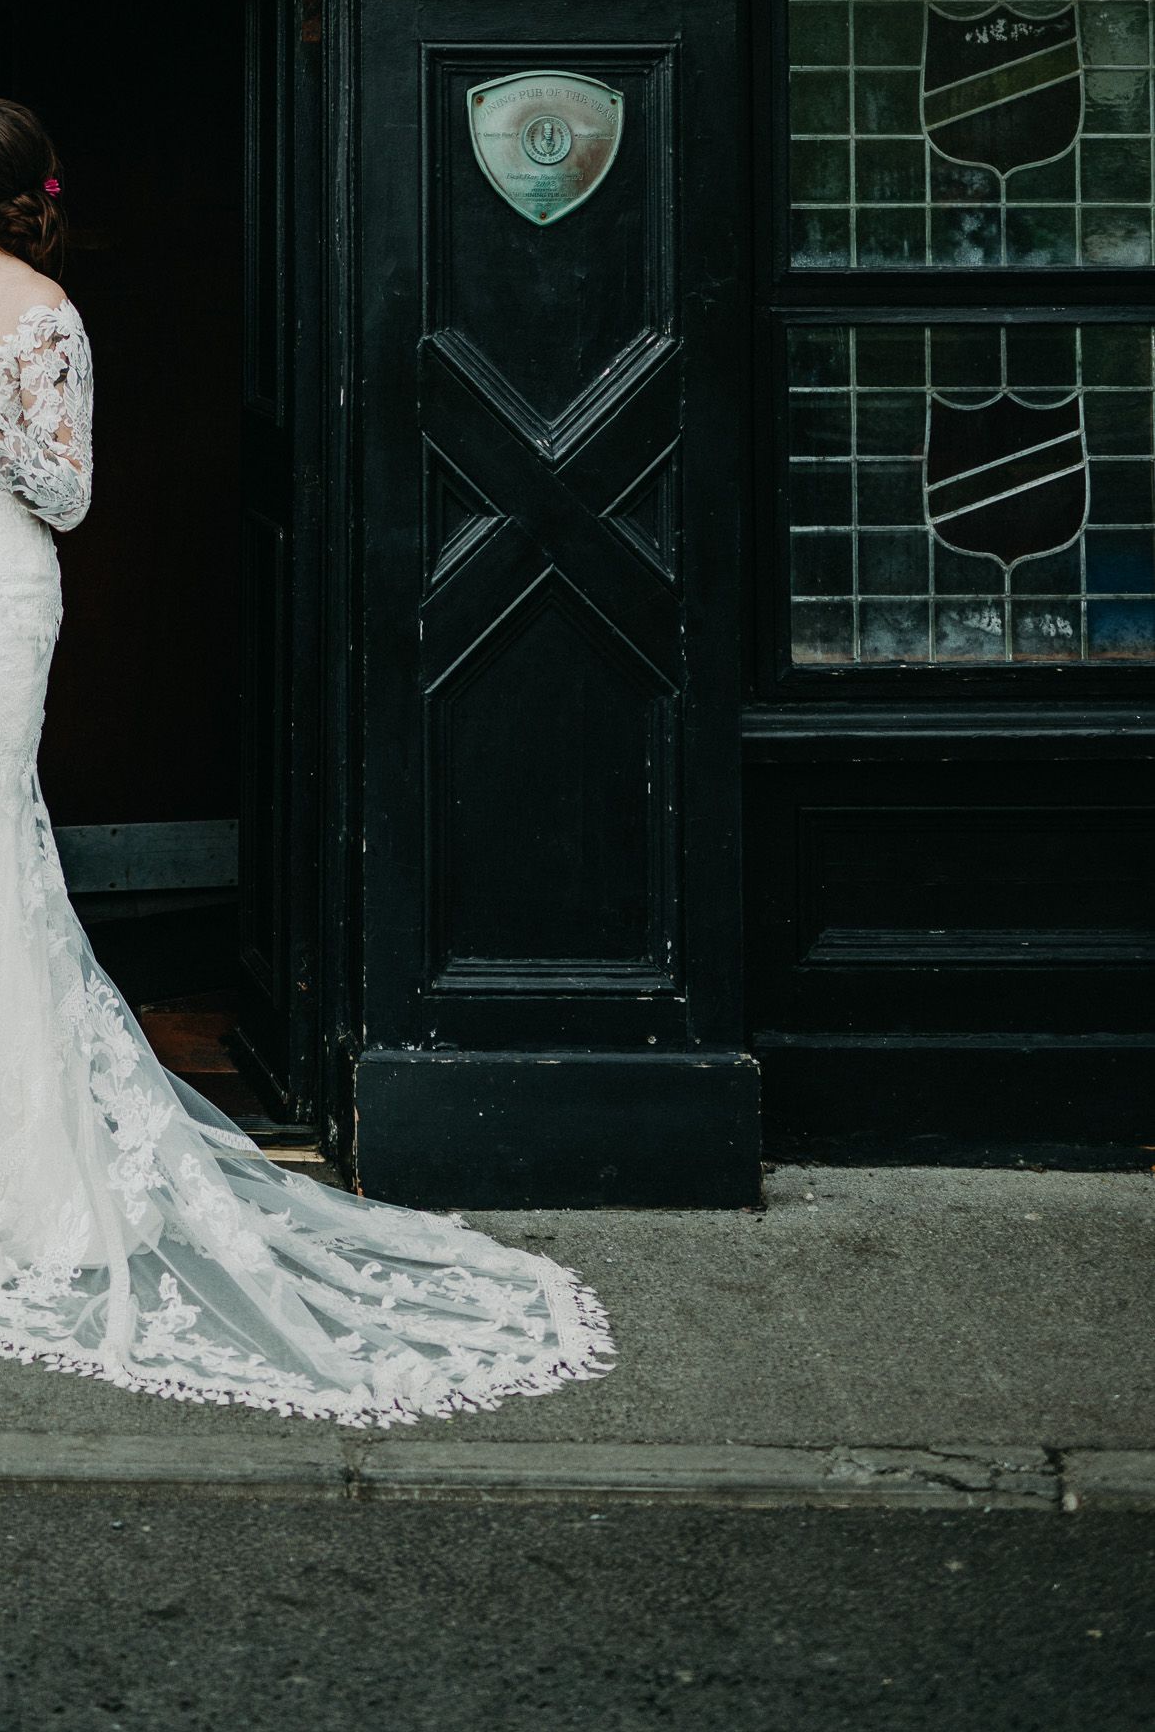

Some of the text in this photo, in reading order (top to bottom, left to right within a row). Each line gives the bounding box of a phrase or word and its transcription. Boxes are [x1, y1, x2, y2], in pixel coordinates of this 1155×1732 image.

[518, 88, 543, 100] PUB
[545, 88, 562, 98] OF
[565, 89, 588, 105] THE
[590, 99, 617, 125] YEAR
